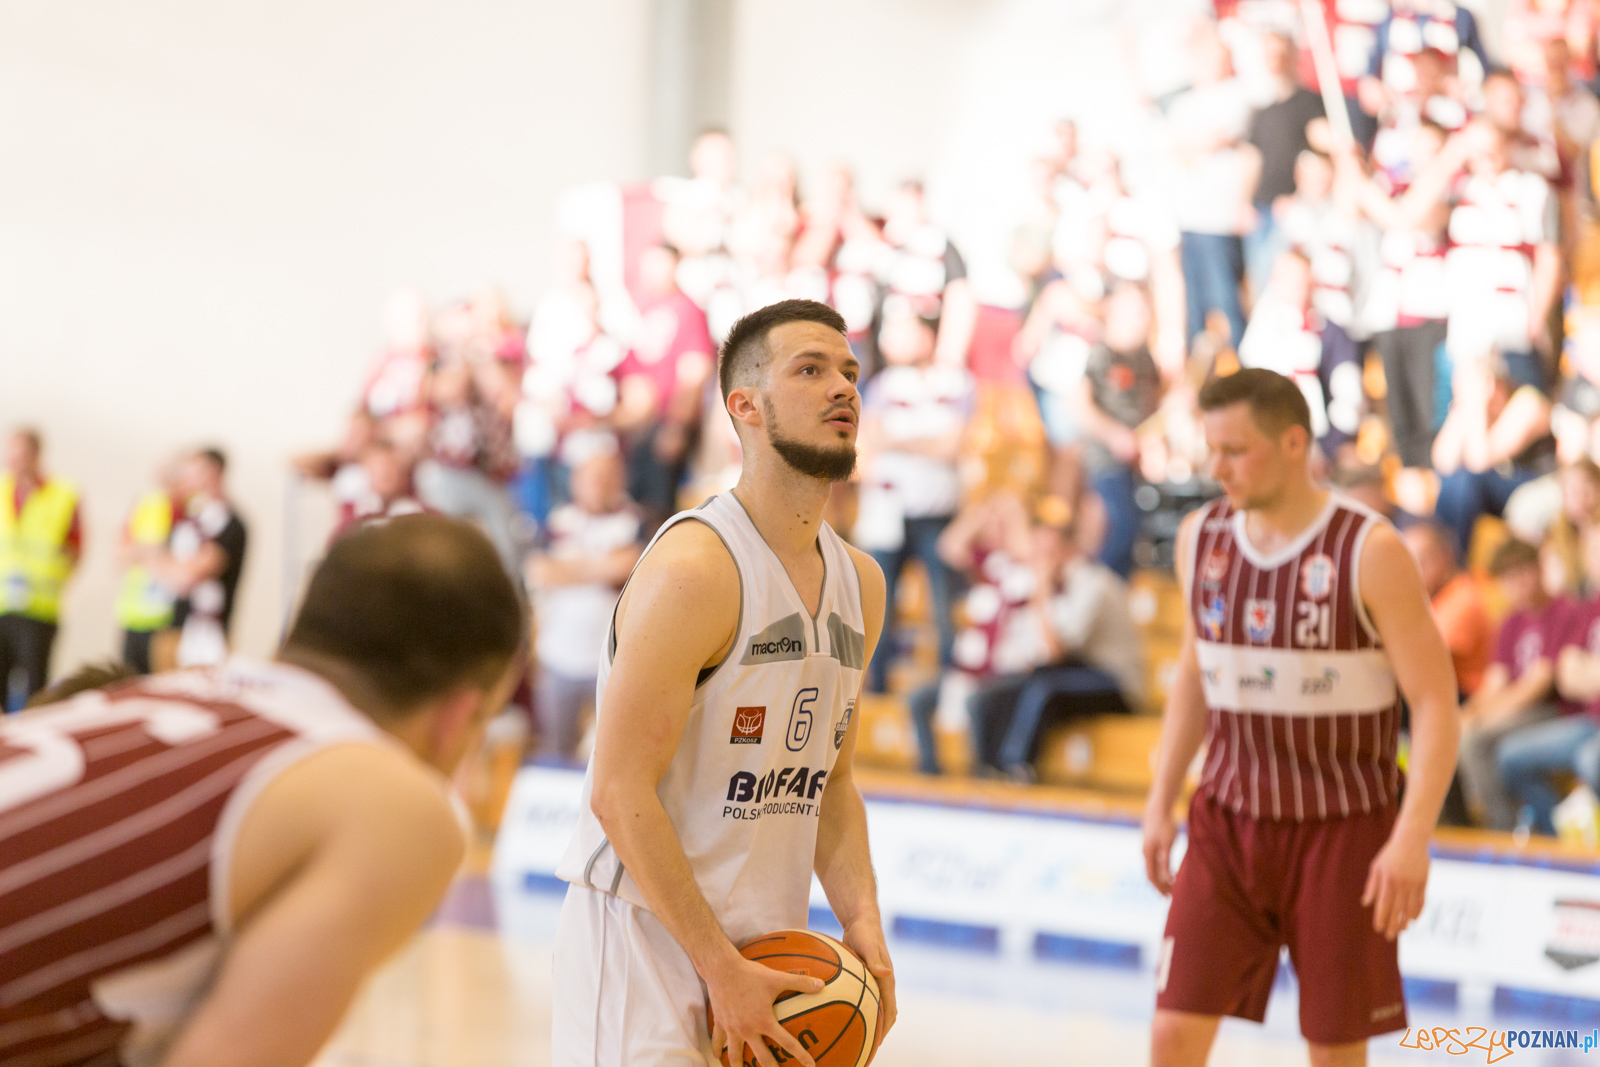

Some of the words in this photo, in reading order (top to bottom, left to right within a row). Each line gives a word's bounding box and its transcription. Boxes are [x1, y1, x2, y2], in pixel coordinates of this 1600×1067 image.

[1296, 600, 1330, 647] 21
[751, 636, 802, 656] macron
[785, 687, 819, 752] 6
[726, 767, 829, 803] BIOFAR
[722, 805, 762, 820] POLSK
[762, 802, 814, 816] RODUCENT
